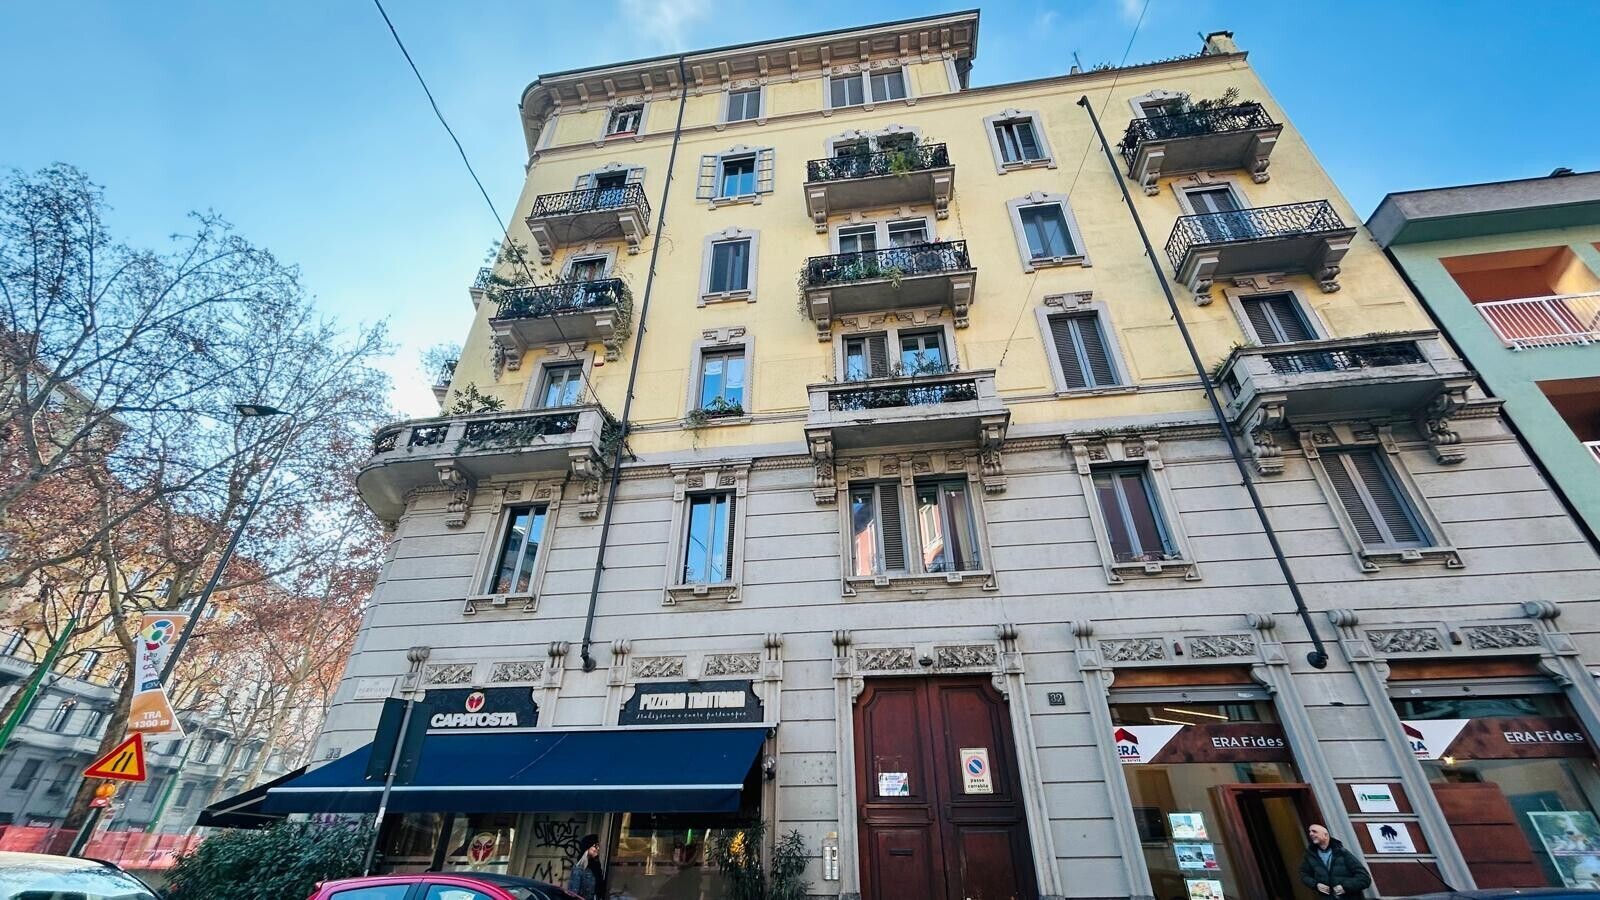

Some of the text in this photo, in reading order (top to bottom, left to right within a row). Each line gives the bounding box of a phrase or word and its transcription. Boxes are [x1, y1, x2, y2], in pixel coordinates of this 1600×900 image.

[1050, 693, 1062, 703] 32
[143, 711, 162, 720] TRA
[430, 712, 518, 728] CAPATOSTA
[134, 719, 159, 728] 1300
[1503, 730, 1584, 742] ERA Fides
[1212, 736, 1284, 748] ERA Fides
